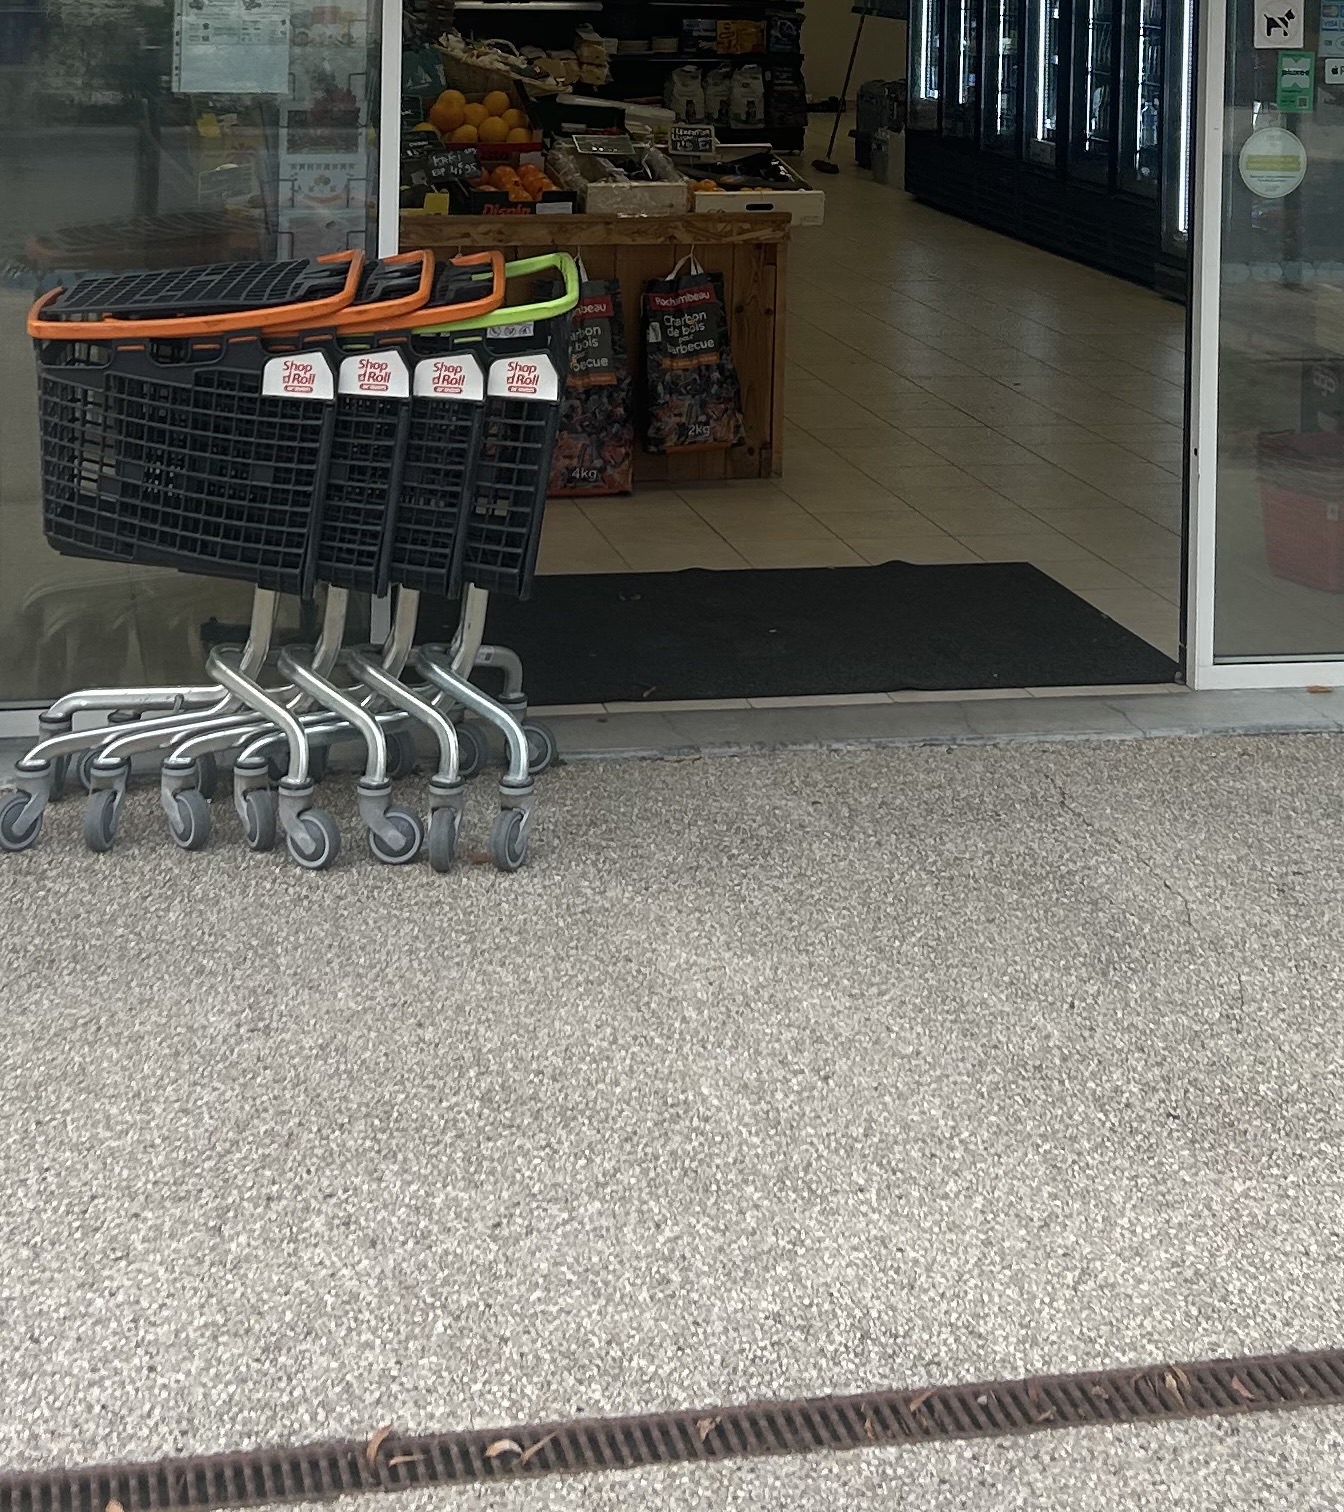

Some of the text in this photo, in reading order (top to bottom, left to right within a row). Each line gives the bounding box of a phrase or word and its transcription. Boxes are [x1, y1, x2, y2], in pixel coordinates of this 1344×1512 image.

[663, 310, 707, 327] Charbon
[667, 321, 705, 338] de bois
[667, 338, 715, 355] barbecue
[283, 360, 312, 375] Shop
[358, 358, 388, 374] Shop
[433, 362, 463, 375] Shop
[507, 361, 537, 375] Shop
[292, 373, 316, 385] Roll
[367, 371, 391, 383] Roll
[442, 374, 465, 386] Roll
[516, 374, 540, 386] Roll
[688, 424, 711, 437] 2kg
[571, 466, 598, 480] 4kg
